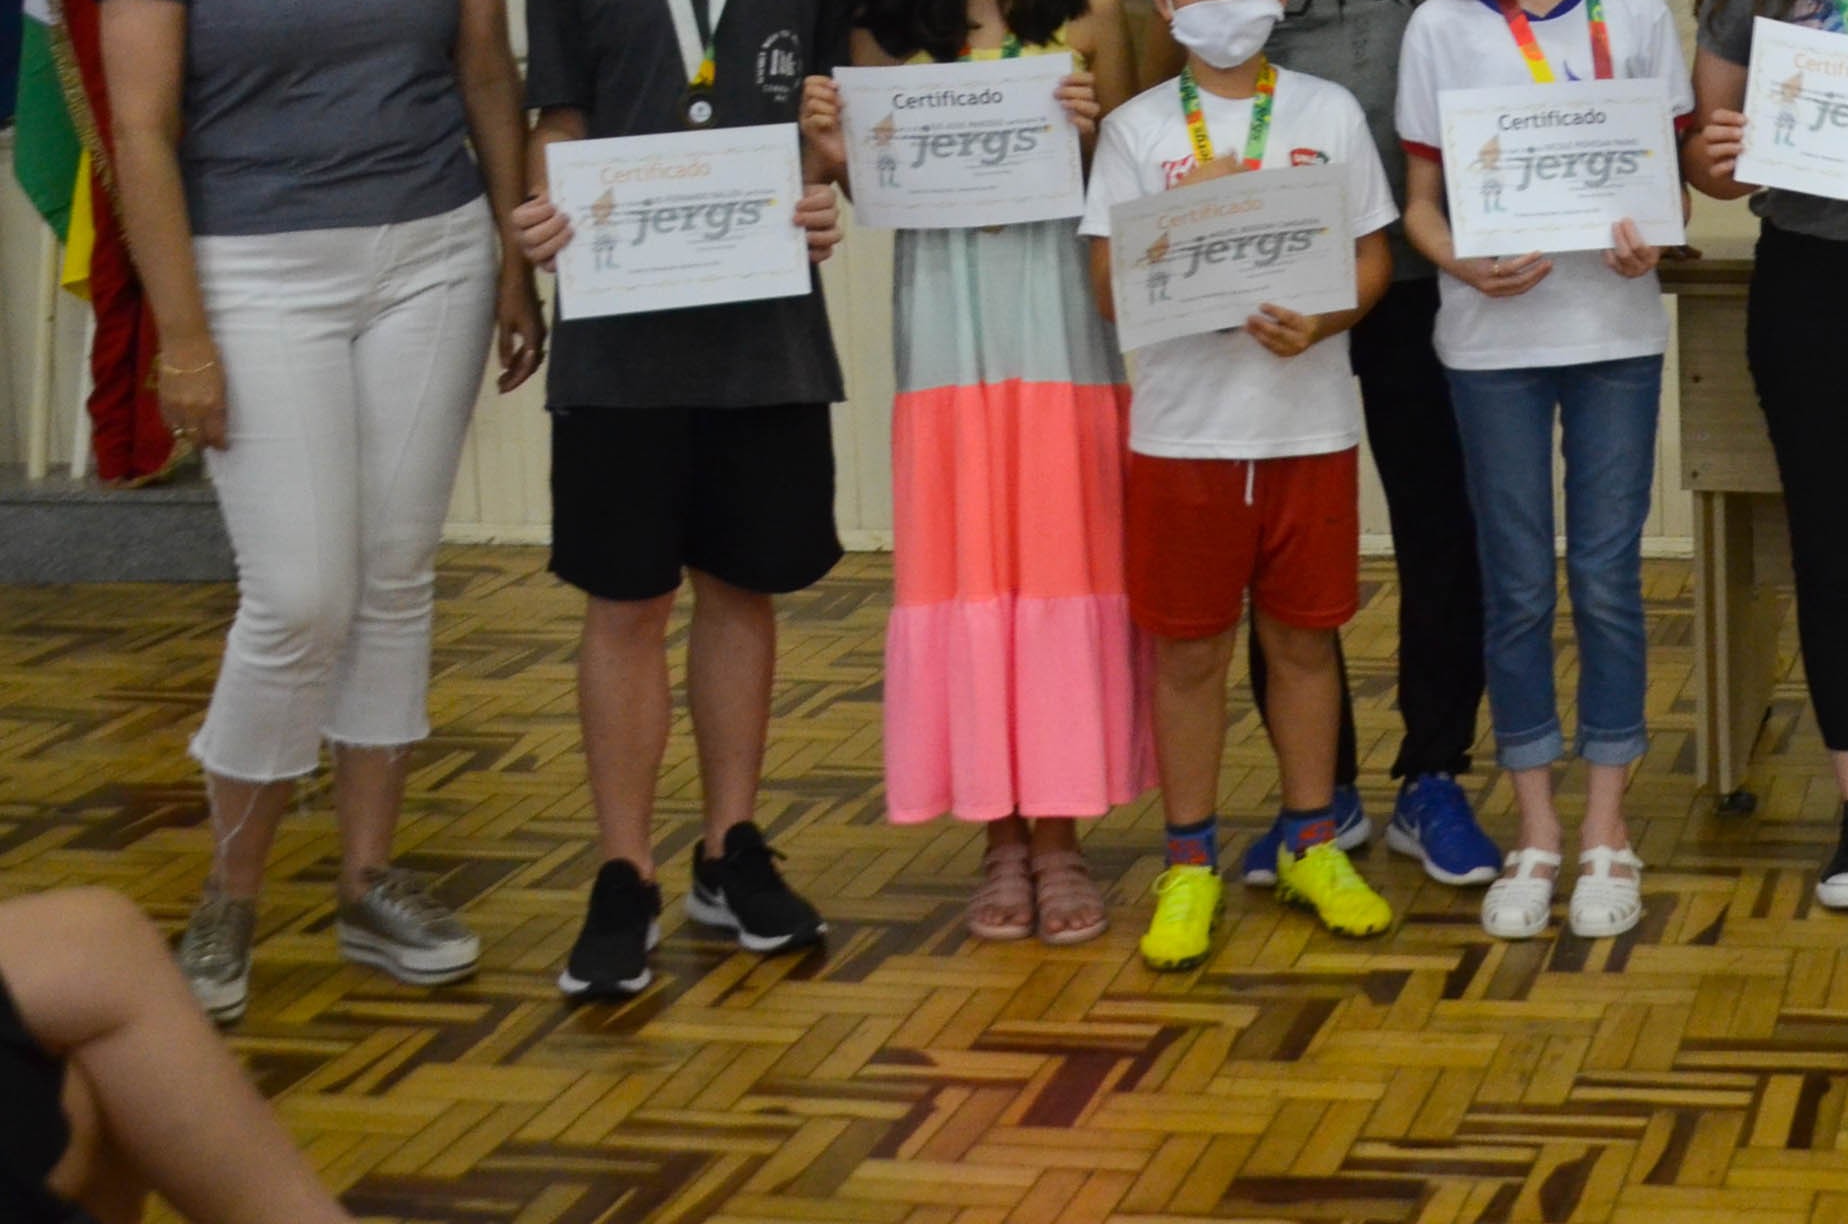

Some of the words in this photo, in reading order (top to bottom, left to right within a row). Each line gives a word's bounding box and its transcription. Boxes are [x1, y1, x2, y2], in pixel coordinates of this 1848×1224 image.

[893, 89, 1004, 110] Certificado
[1498, 109, 1607, 131] Certificado
[911, 124, 1045, 168] jergs
[1515, 147, 1648, 192] jergs
[631, 197, 771, 246] jergs
[1183, 227, 1322, 279] jergs
